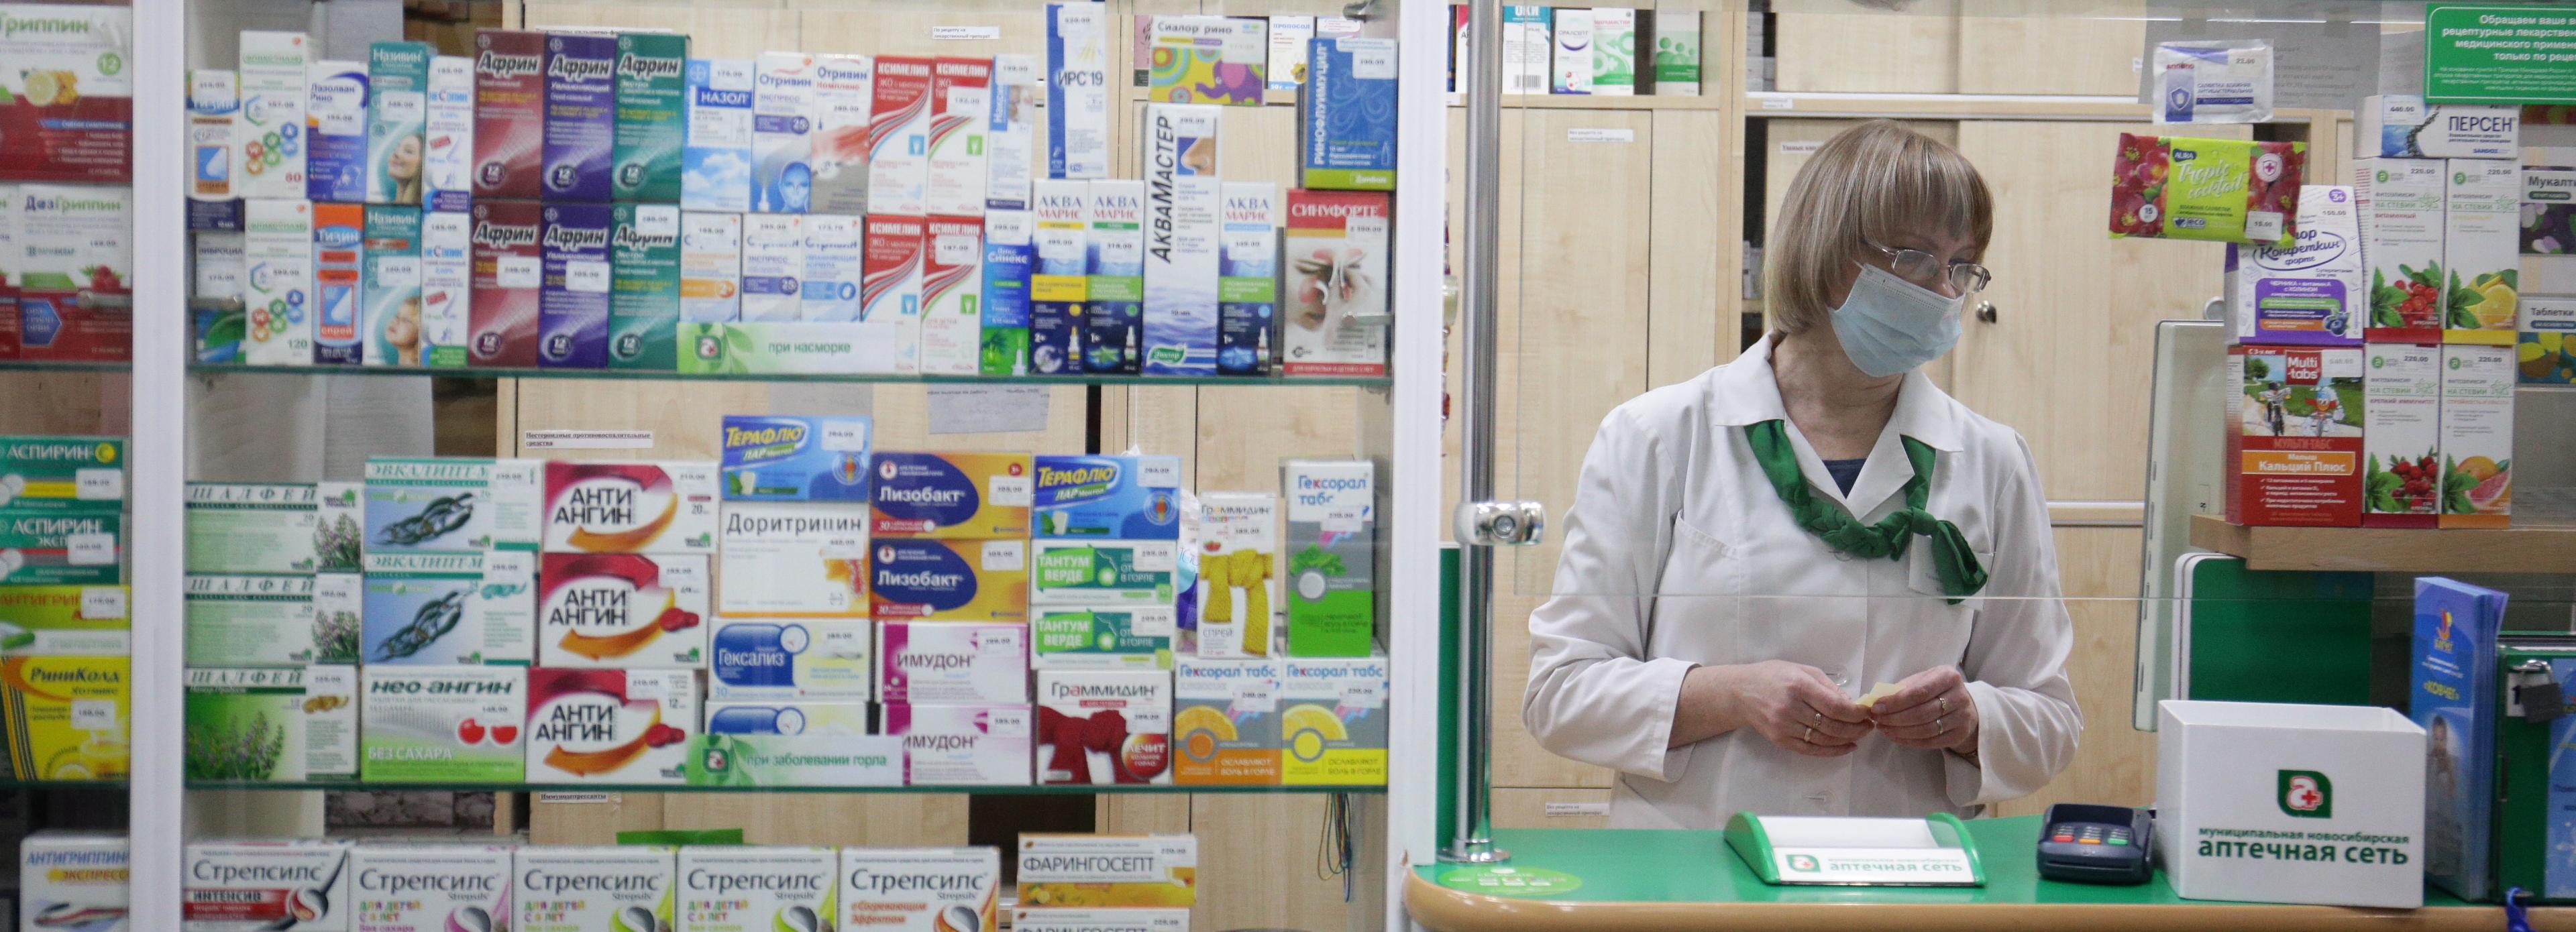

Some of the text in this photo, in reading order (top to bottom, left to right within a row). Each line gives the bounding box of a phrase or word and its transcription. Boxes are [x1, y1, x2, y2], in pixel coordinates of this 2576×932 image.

[2479, 15, 2566, 25] Обращаем ваше
[1157, 22, 1233, 36] Сиалор рино
[2442, 28, 2514, 38] рецептурные
[2455, 41, 2530, 50] медицинского
[374, 49, 422, 62] Називин
[2493, 52, 2530, 61] только
[103, 56, 117, 71] 12
[478, 52, 539, 76] Африн
[550, 55, 611, 80] Африн
[619, 54, 680, 78] Африн
[877, 63, 929, 76] КСИМЕЛИН
[936, 63, 987, 77] КСИМЕЛИН
[817, 66, 867, 80] Отривин
[1058, 71, 1104, 86] ИРС 19
[311, 83, 355, 93] Лазолван
[551, 82, 609, 92] Увлажняющий
[759, 74, 812, 88] Отривин
[310, 95, 333, 103] Рино
[701, 92, 747, 105] НАЗОЛ
[2449, 117, 2512, 132] ПЕРСЕН
[2175, 152, 2196, 160] AURA
[286, 172, 302, 182] 60
[2178, 160, 2231, 182] Tropic
[1354, 174, 1387, 184] Zambon
[2188, 172, 2245, 200] cocktail
[1150, 115, 1175, 264] АКВАМАСТЕР
[1039, 196, 1082, 208] АКВА
[1094, 196, 1138, 208] АКВА
[1226, 198, 1269, 209] АКВА
[1037, 209, 1081, 220] МАРИС
[1092, 209, 1136, 220] МАРИС
[1291, 203, 1380, 219] СИНУФОРТЕ
[369, 212, 416, 225] Називин
[319, 229, 358, 242] Тизин
[474, 222, 535, 246] Африн
[869, 223, 921, 235] КСИМЕЛИН
[928, 223, 980, 235] КСИМЕЛИН
[545, 225, 606, 249] Африн
[2259, 240, 2341, 261] Конфеткин
[2285, 255, 2316, 266] форте
[2531, 307, 2574, 316] Таблетки
[288, 339, 307, 349] 120
[769, 343, 851, 355] при насморке
[2287, 356, 2318, 367] Multi
[2287, 368, 2318, 380] -tabs
[573, 432, 651, 441] противовоспалительные
[726, 426, 805, 448] ТЕРАФЛЮ
[7, 444, 90, 461] АСПИРИН
[376, 465, 472, 477] ЭВКАЛИПТ
[2259, 461, 2347, 473] Кальций Плюс
[1038, 467, 1116, 487] ТЕРАФЛЮ
[1298, 475, 1366, 492] Гексорал
[193, 486, 317, 501] ШАЛФЕЙ
[570, 489, 632, 505] АНТИ
[879, 486, 961, 503] Лизобакт
[1299, 491, 1334, 506] табс
[553, 507, 632, 524] АНГИН
[692, 505, 702, 515] 20
[12, 518, 101, 535] АСПИРИН
[727, 513, 861, 536] Доритрицин
[1038, 555, 1090, 568] ТАНТУМ
[877, 571, 959, 587] Лизобакт
[1044, 569, 1083, 583] ВЕРДЕ
[191, 578, 315, 593] ШАЛФЕЙ
[564, 589, 626, 606] АНТИ
[549, 608, 626, 625] АНГИН
[1038, 620, 1089, 632] ТАНТУМ
[1044, 634, 1083, 648] ВЕРДЕ
[718, 648, 785, 667] Гексализ
[897, 653, 971, 670] ИМУДОН
[1180, 663, 1277, 680] Гексорал табс
[1286, 663, 1347, 680] Гексорал
[1051, 681, 1155, 699] Граммидин
[550, 705, 612, 722] АНТИ
[535, 724, 612, 741] АНГИН
[368, 746, 453, 761] БЕЗ САХАРА
[1128, 743, 1167, 753] ЛЕЧИТ
[747, 752, 887, 768] при заболевании горла
[2199, 827, 2410, 845] муниципальная новосибирская
[2198, 840, 2408, 865] аптечная сеть
[1023, 856, 1154, 872] ФАРИНГОСЕПТ
[1829, 862, 1963, 872] аптечная сеть
[193, 861, 322, 886] Стрепсилс
[360, 868, 495, 896] Стрепсилс
[524, 868, 659, 896] Стрепсилс
[688, 868, 823, 895] Стрепсилс
[850, 868, 984, 895] Стрепсилс
[193, 890, 262, 903] ИНТЕНСИВ
[448, 891, 487, 903] Strepsils
[612, 891, 651, 903] Strepsils
[386, 900, 421, 913] ДЕТЕЙ
[378, 913, 400, 923] ЛЕТ
